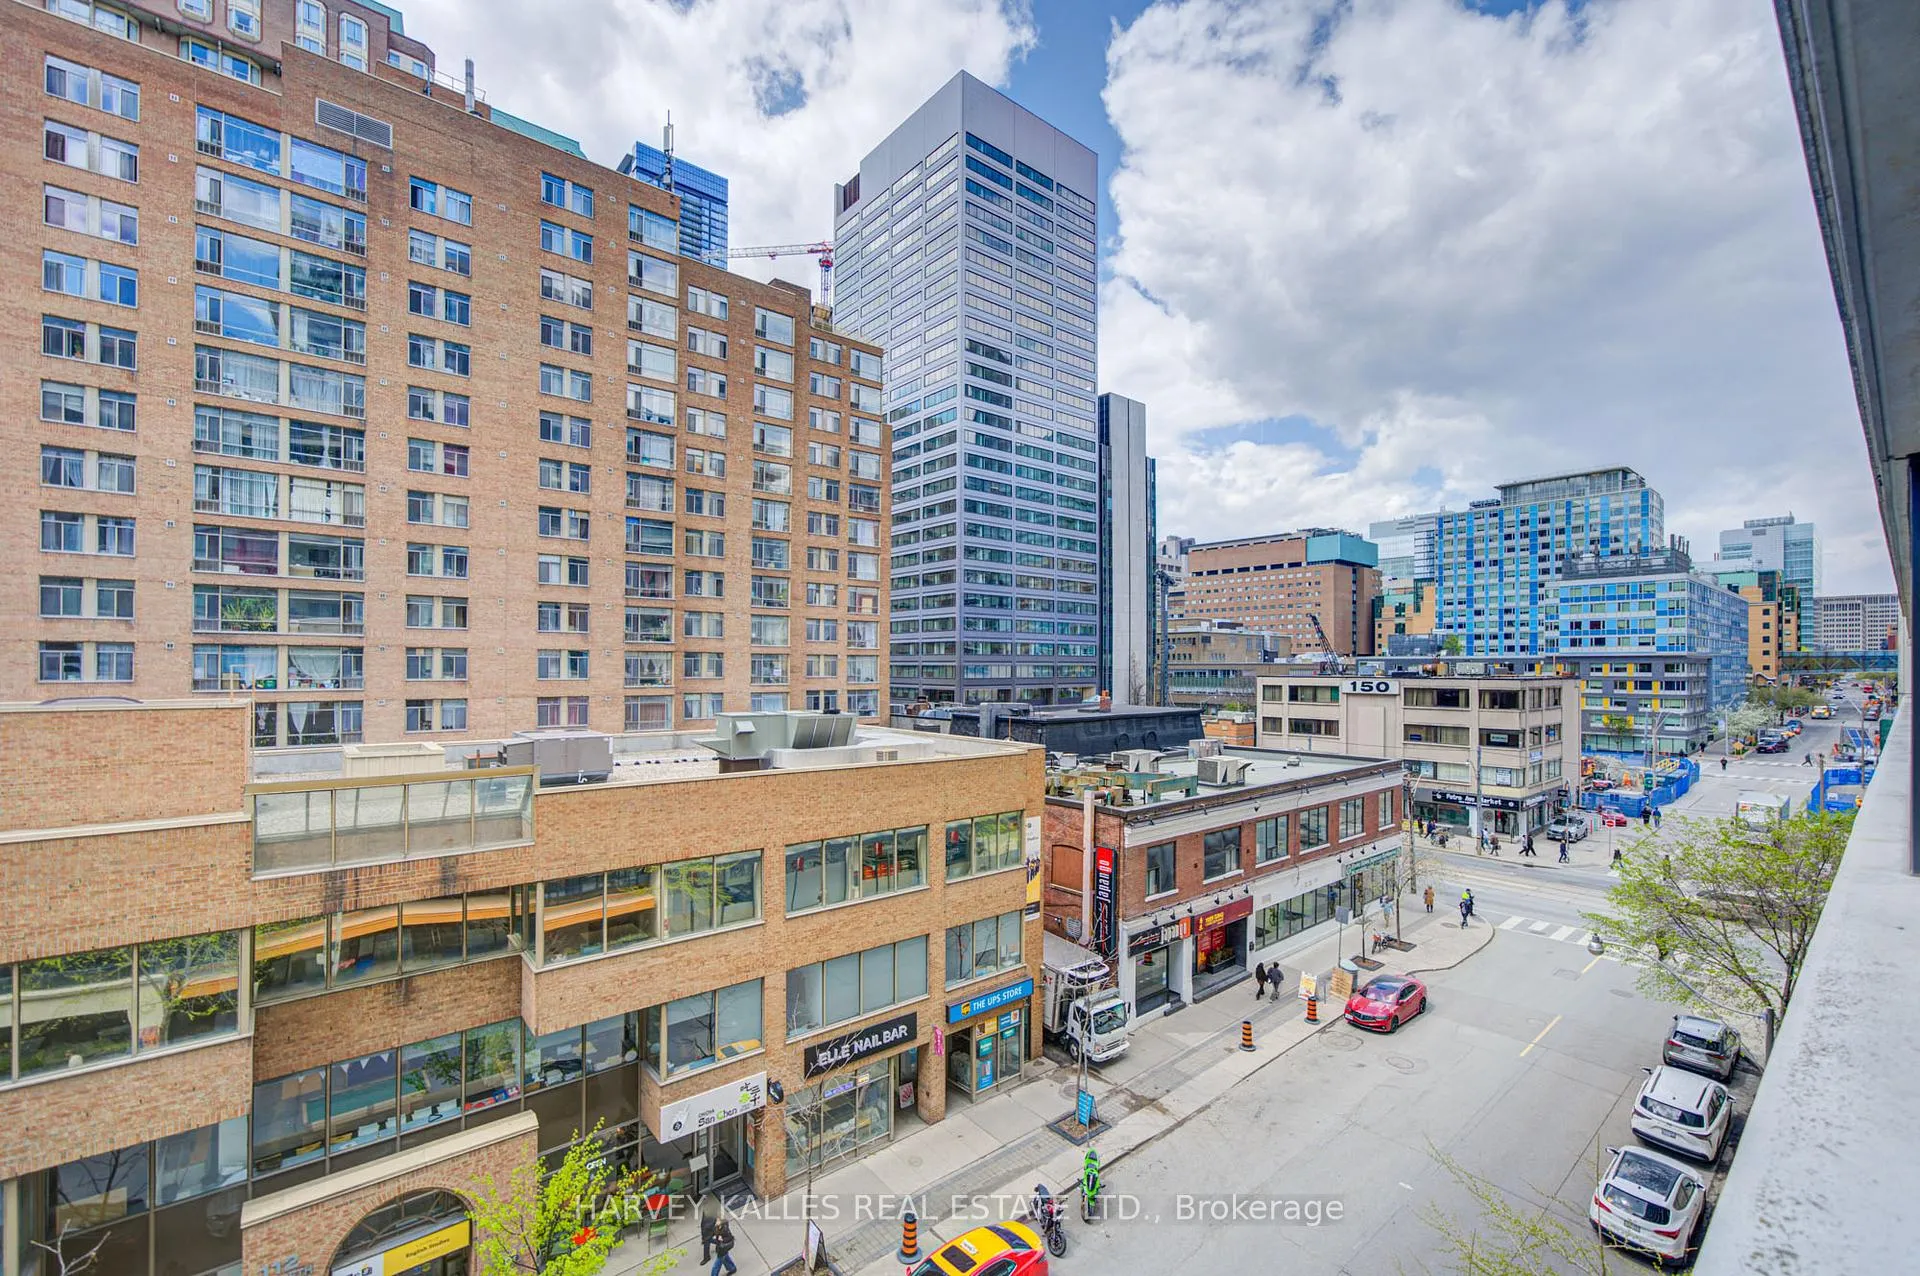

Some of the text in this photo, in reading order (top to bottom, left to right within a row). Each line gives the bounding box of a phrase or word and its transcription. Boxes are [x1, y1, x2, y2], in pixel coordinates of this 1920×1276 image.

[1350, 681, 1390, 693] 150
[973, 998, 986, 1011] THE
[987, 993, 1001, 1006] UPS
[1002, 986, 1022, 1001] STORE
[818, 1025, 908, 1067] ELLE NAIL BAR
[698, 1108, 738, 1127] San Chen
[586, 1157, 607, 1170] OPN
